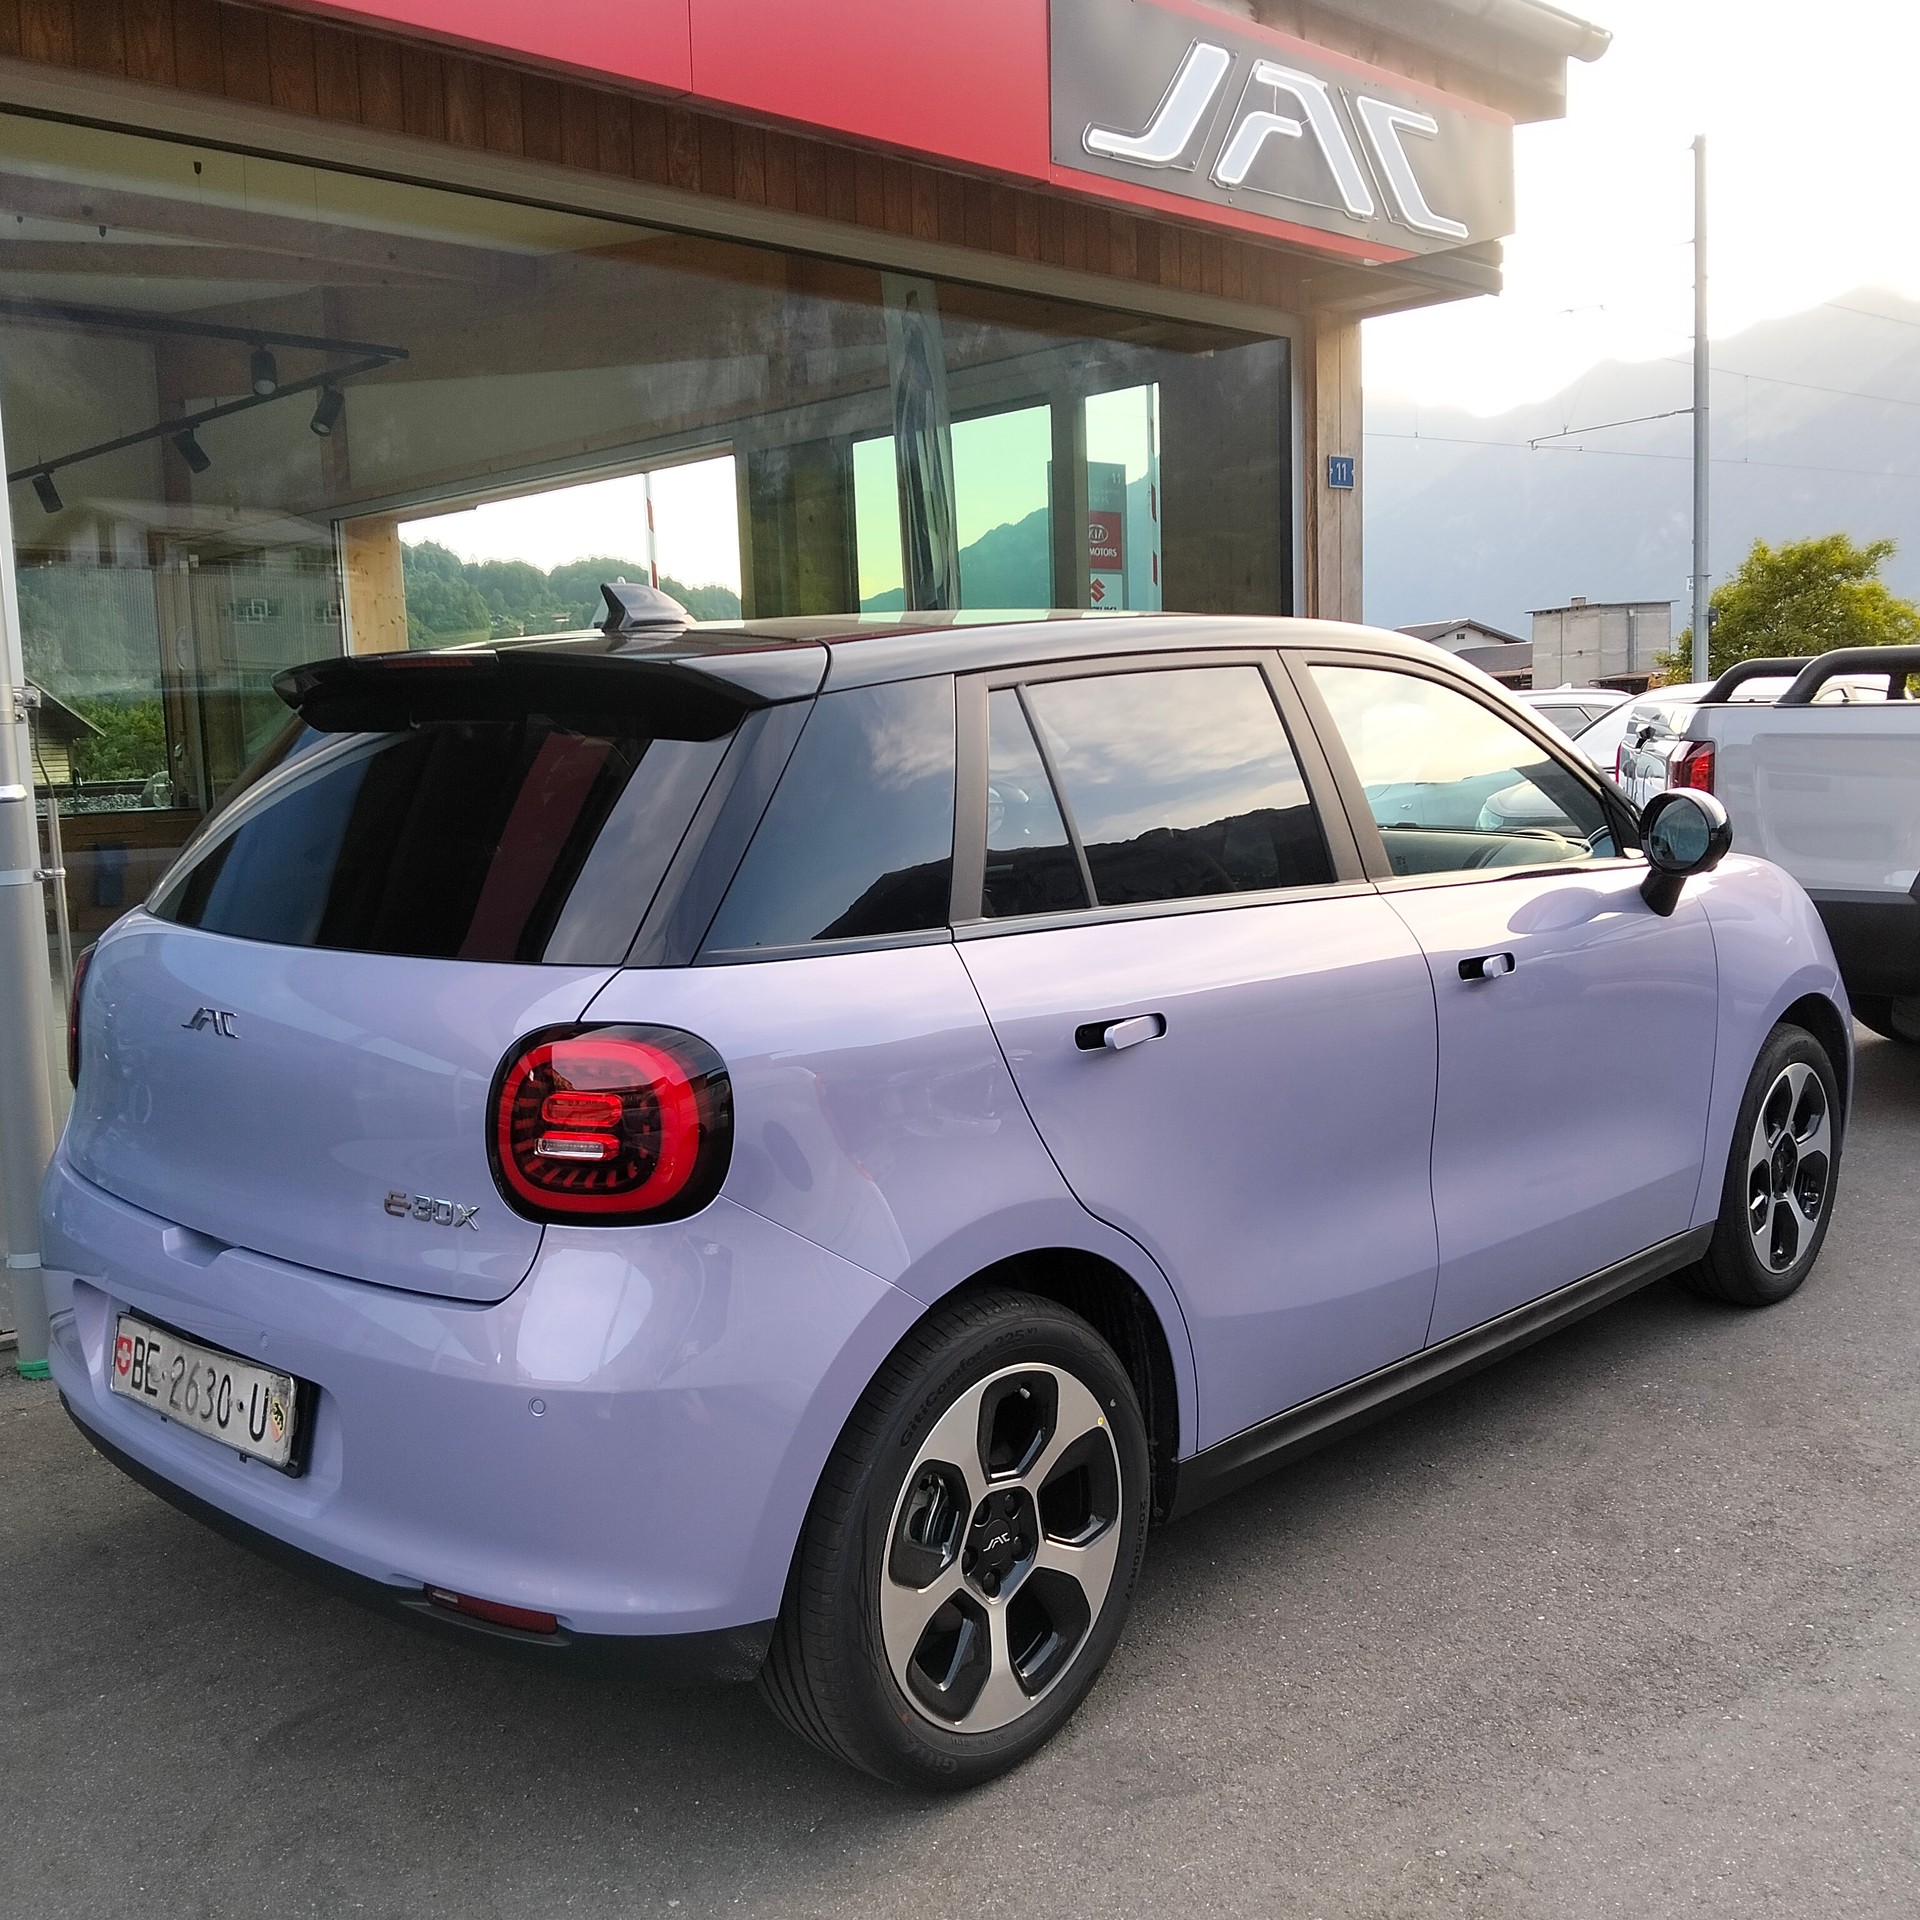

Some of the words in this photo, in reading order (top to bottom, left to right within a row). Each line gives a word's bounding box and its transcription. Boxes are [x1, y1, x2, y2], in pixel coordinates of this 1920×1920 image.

[1085, 40, 1470, 239] JAC
[1111, 471, 1121, 485] 11
[1336, 461, 1347, 482] 11
[181, 1006, 240, 1039] JAC
[982, 1532, 1011, 1552] JAC
